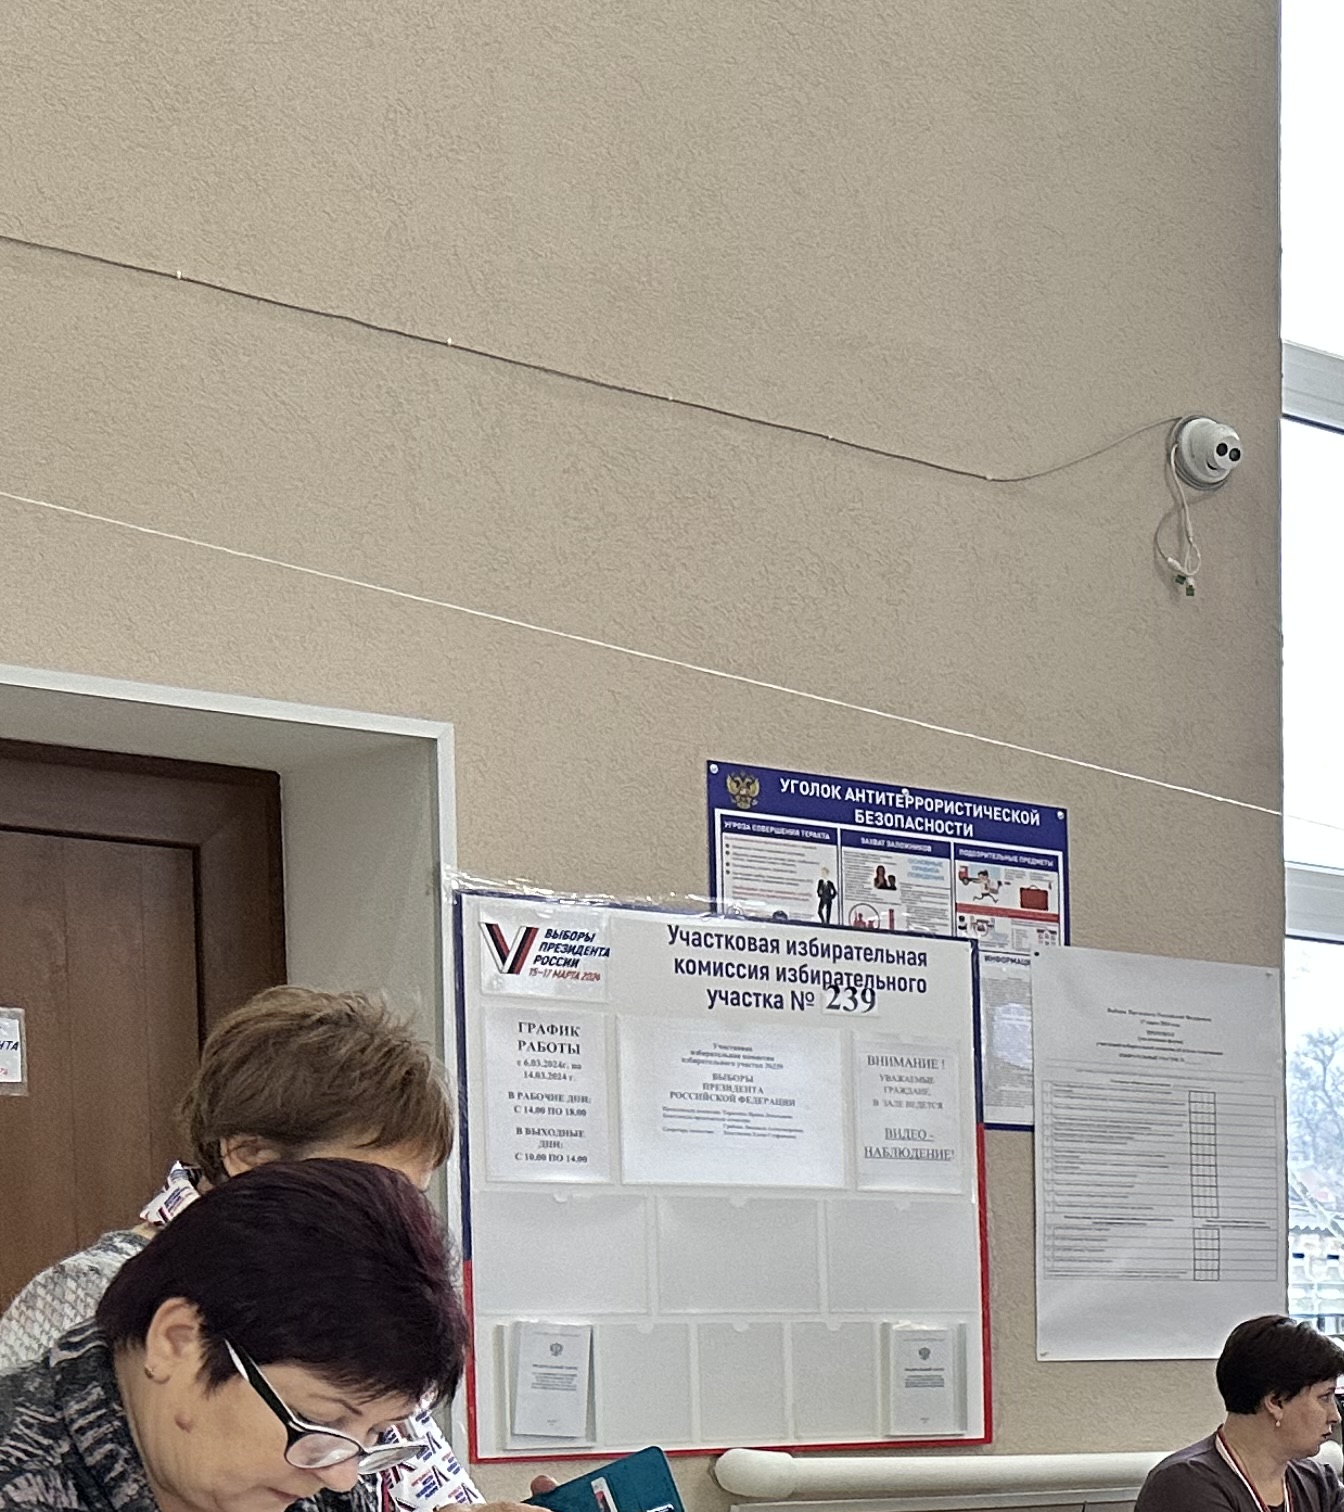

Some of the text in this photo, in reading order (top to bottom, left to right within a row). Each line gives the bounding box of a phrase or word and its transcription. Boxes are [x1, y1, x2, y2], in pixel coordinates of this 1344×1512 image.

[780, 778, 1040, 827] УГОЛОК АНТИТЕРРОРИСТИЧЕСКОЙ
[855, 809, 974, 838] БЕЗОПАСНОСТИ
[545, 928, 596, 942] ВЫБОРЫ
[538, 942, 610, 957] ПРЕЗИДЕНТА
[667, 924, 928, 967] Участковая избирательная
[533, 955, 580, 968] РОССИИ
[552, 970, 580, 980] МАРТА
[581, 972, 601, 981] 2024
[674, 957, 928, 993] комиссия избирательного
[707, 986, 877, 1013] участка № 239
[518, 1021, 581, 1037] ГРАФИК
[517, 1040, 581, 1055] РАБОТЫ
[867, 1055, 939, 1070] ВНИМАНИЕ
[712, 1073, 754, 1083] ВЫБОРЫ
[508, 1091, 515, 1100] В
[517, 1092, 565, 1102] РАБОЧИЕ
[702, 1083, 764, 1095] ПРЕЗИДЕНТА
[669, 1091, 796, 1107] РОССИЙСКОЙ ФЕДЕРАЦИИ
[516, 1127, 584, 1138] В ВЫХОДНЫЕ
[885, 1127, 928, 1140] ВИДЕО
